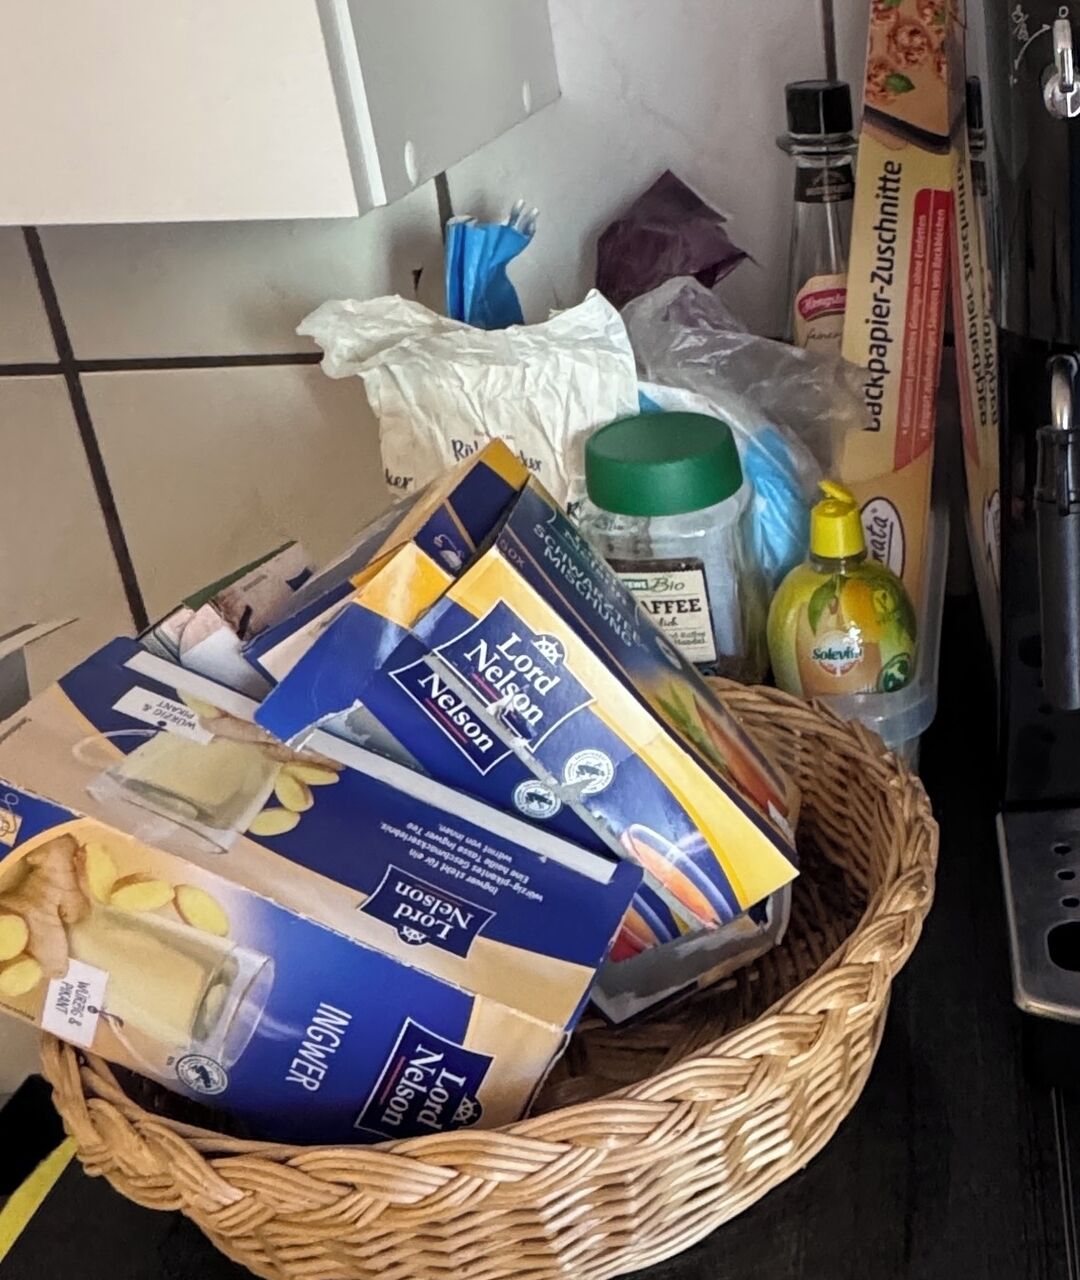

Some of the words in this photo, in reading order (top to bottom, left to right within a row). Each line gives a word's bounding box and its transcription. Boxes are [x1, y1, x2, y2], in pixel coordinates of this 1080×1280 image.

[649, 576, 685, 593] Bio
[543, 547, 634, 647] MISCHUNG
[496, 633, 560, 695] Lord
[463, 638, 545, 725] Nelson
[155, 699, 195, 720] PIKANT
[417, 673, 494, 752] Nelson
[405, 821, 424, 835] Tee
[422, 829, 457, 851] Ingwer
[464, 835, 482, 849] von
[407, 847, 425, 862] ein
[423, 854, 440, 869] für
[456, 845, 483, 862] Tasse
[439, 862, 466, 881] steht
[509, 868, 530, 883] Eine
[464, 873, 499, 895] Ingwer
[394, 881, 473, 928] Nelson
[393, 902, 453, 939] Lord
[54, 980, 74, 1015] PIKANT
[67, 1017, 82, 1026] &
[286, 1003, 351, 1091] INGWER
[381, 1044, 443, 1125] Nelson
[416, 1067, 465, 1128] Lord
